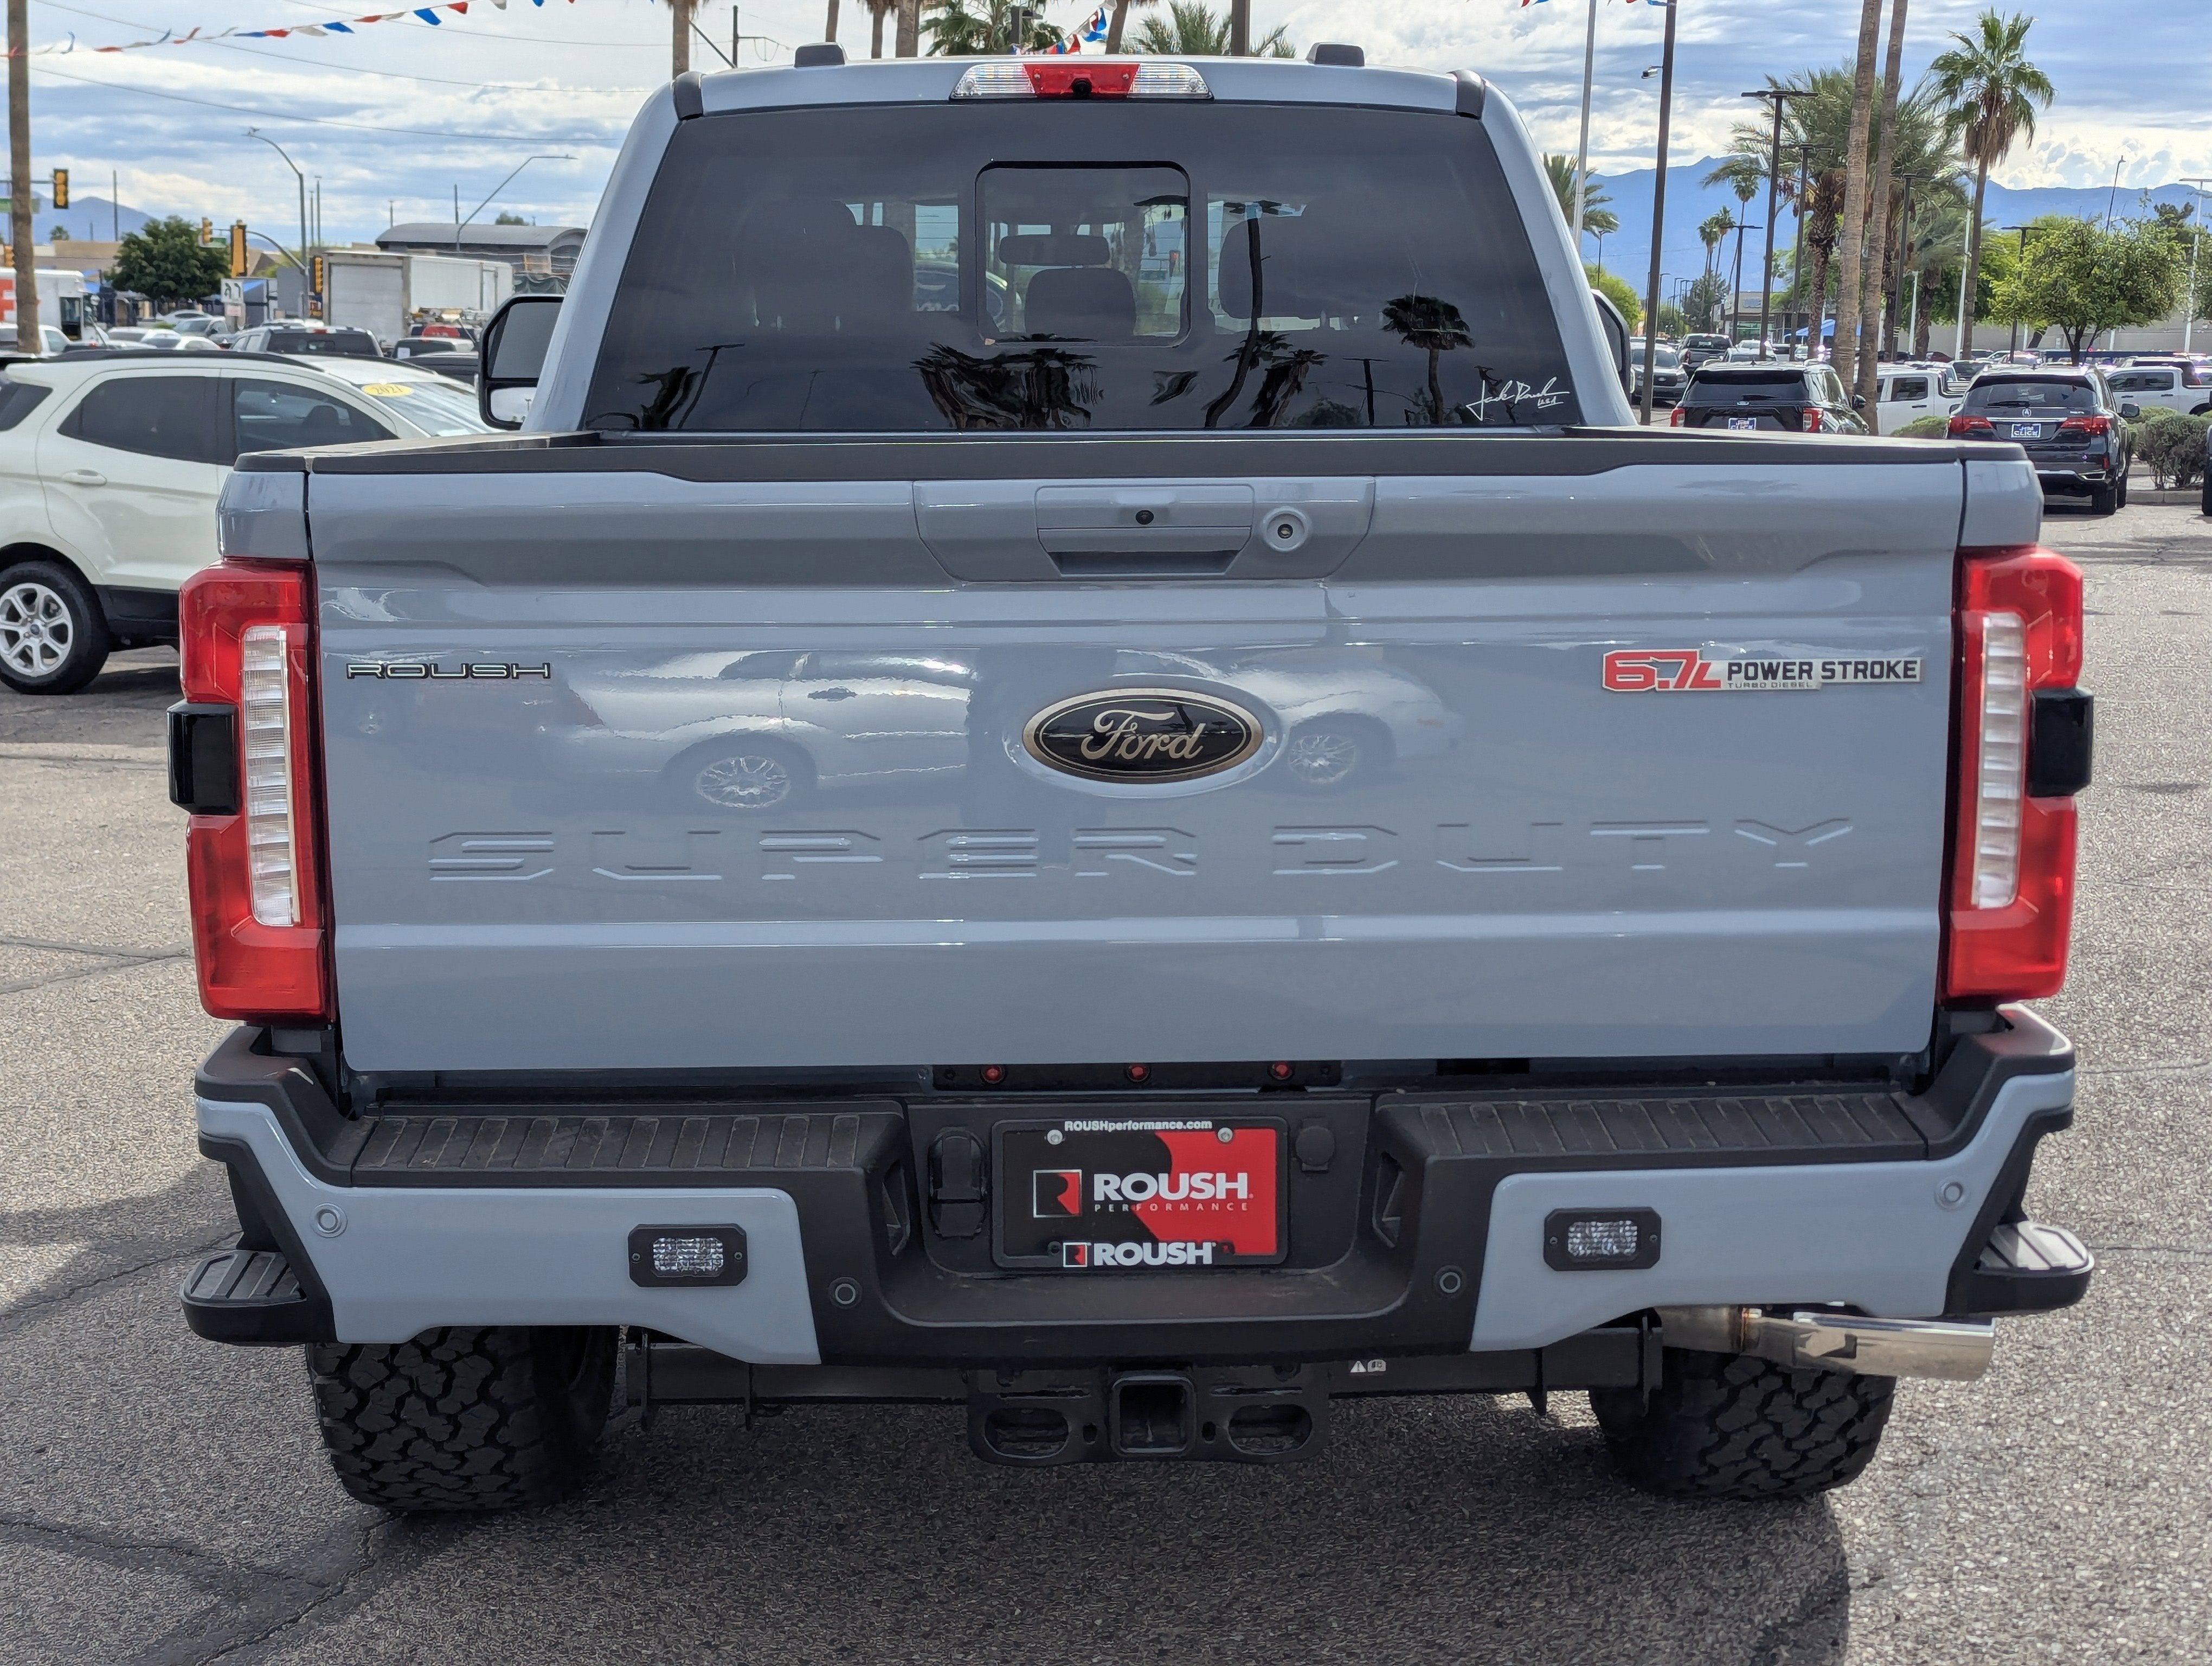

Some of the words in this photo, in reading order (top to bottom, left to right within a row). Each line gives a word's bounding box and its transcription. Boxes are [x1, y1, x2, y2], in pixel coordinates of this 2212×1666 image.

[346, 662, 551, 679] ROUSH
[1603, 649, 1722, 691] 6.7L
[1727, 661, 1813, 681] POWER
[1821, 660, 1918, 680] STROKE
[1081, 709, 1206, 760] Ford
[429, 828, 1197, 882] SUPER
[1272, 818, 1853, 875] DUTY
[1064, 1120, 1213, 1132] ROUSHperformance.com
[1094, 1172, 1248, 1201] ROUSH
[1094, 1202, 1249, 1212] PERFORMANCE
[1094, 1242, 1213, 1266] ROUSH
